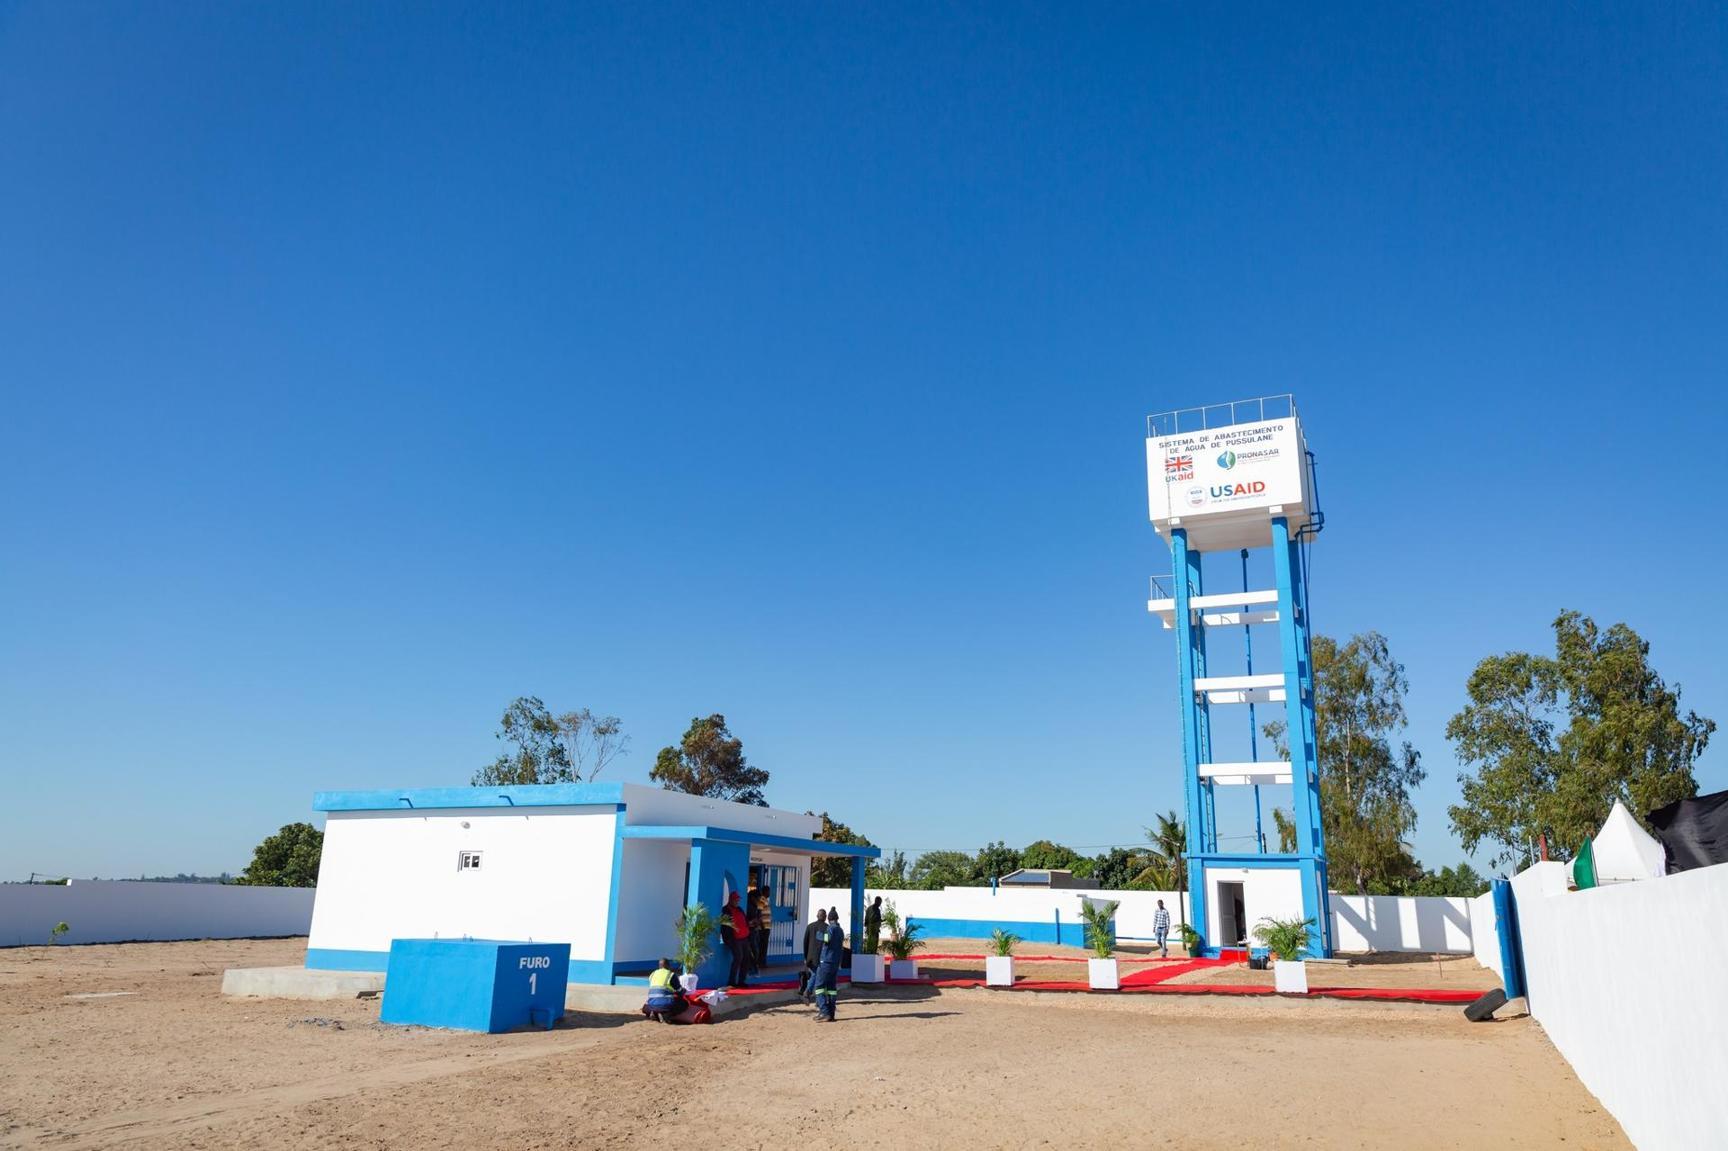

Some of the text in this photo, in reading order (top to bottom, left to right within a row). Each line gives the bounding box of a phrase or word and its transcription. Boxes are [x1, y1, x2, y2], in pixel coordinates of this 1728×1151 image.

[1159, 438, 1195, 449] SISTEMA
[1214, 425, 1284, 441] ABASTECIMENTO
[1225, 434, 1273, 447] PUSSULANE
[1237, 448, 1279, 459] PRONASAR
[1210, 481, 1266, 498] USAID
[519, 956, 551, 969] FURO
[529, 972, 537, 995] 1
